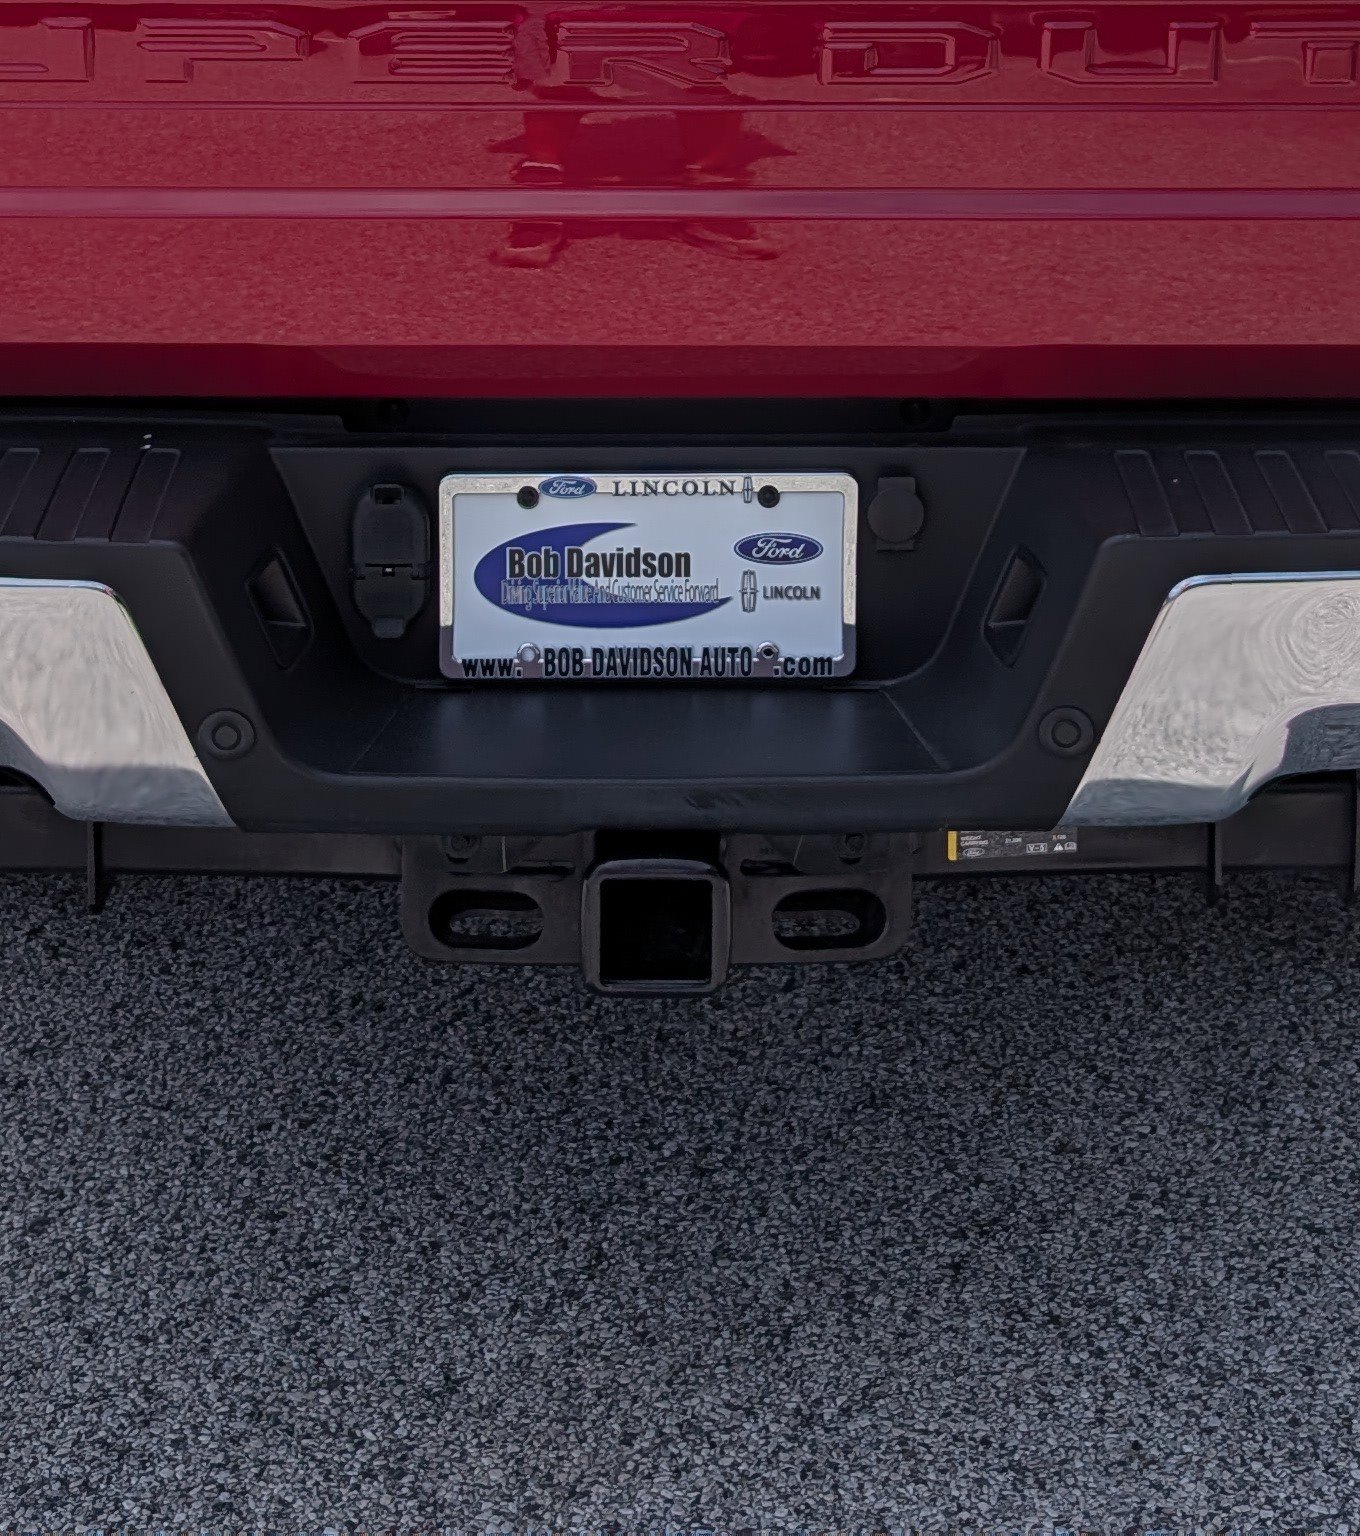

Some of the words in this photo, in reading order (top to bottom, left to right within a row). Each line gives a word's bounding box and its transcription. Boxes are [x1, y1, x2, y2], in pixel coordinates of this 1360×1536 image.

[548, 479, 587, 497] Ford
[612, 479, 737, 497] LINCOLN
[506, 546, 559, 579] Bob
[566, 546, 691, 579] Davidson
[751, 537, 807, 561] Ford
[501, 580, 532, 611] Driving
[532, 580, 567, 611] Superior
[567, 579, 592, 604] Value
[611, 579, 653, 604] Customer
[653, 579, 684, 604] Service
[684, 578, 720, 603] Forward
[762, 585, 821, 601] LINCOLN
[544, 647, 589, 677] BOB
[592, 646, 693, 677] DAVIDSON
[700, 646, 753, 677] AUTO
